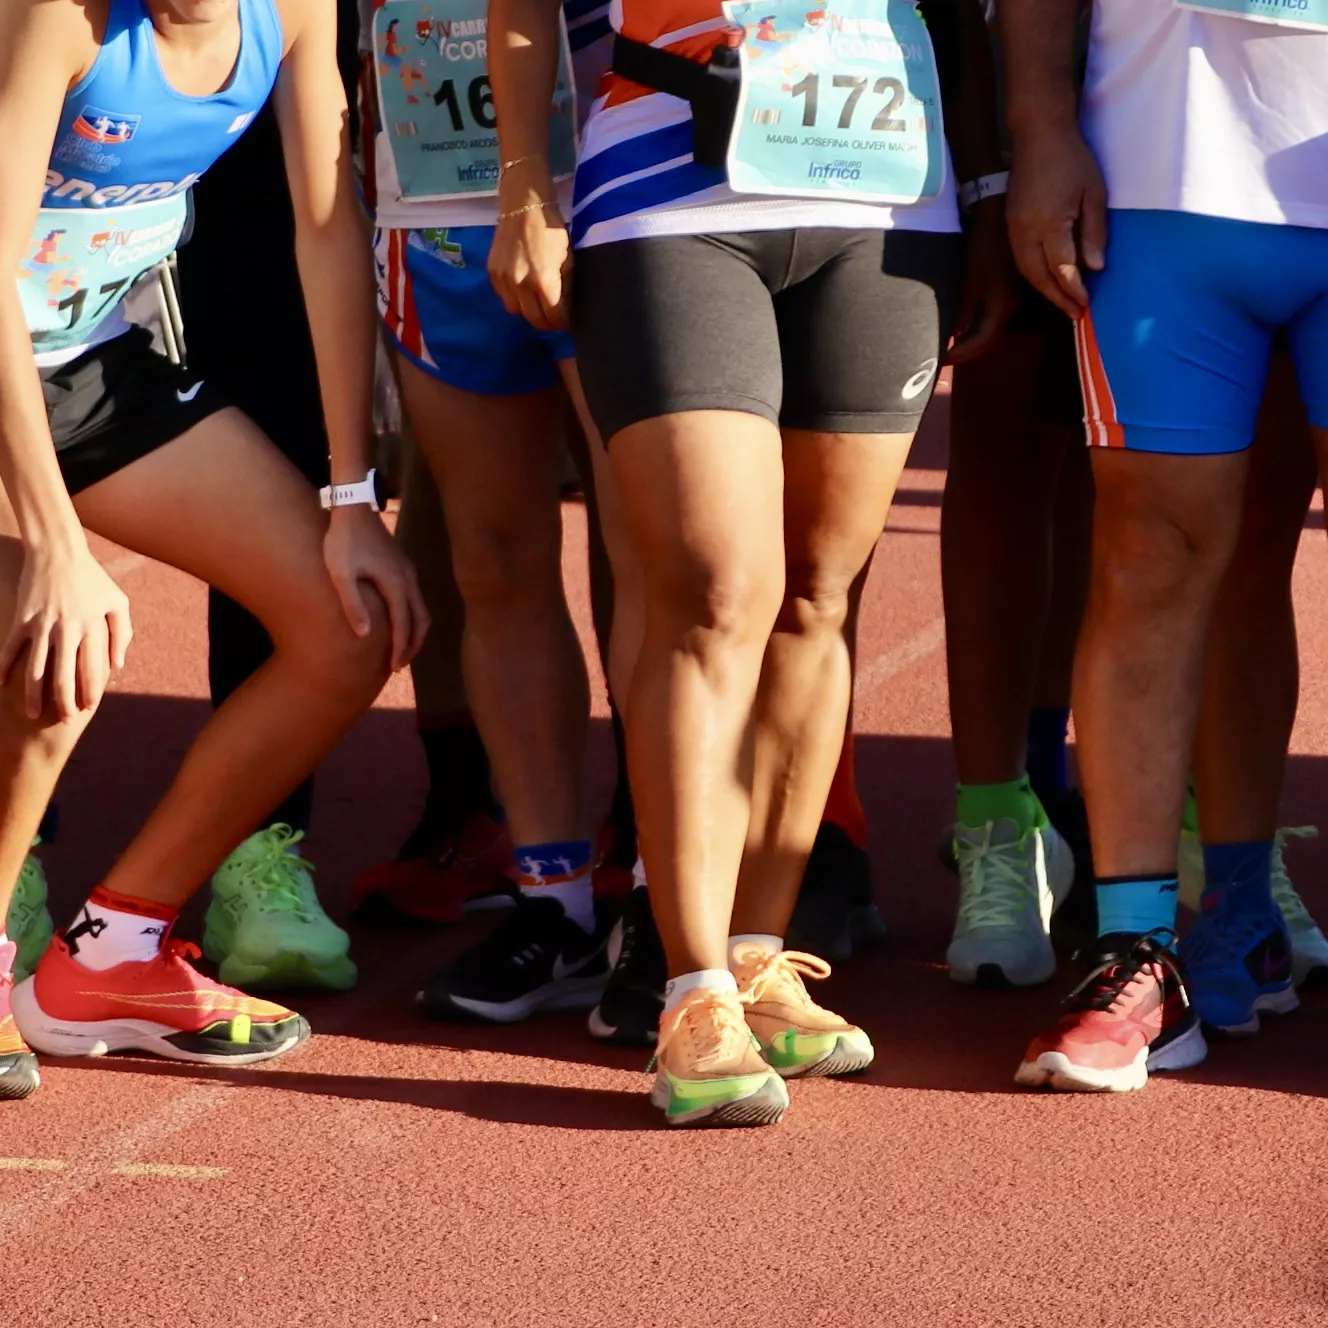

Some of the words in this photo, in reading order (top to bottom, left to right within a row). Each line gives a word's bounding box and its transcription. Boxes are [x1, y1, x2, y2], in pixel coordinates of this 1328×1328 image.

[792, 72, 906, 132] 172
[421, 141, 468, 153] FRANCISCO
[766, 134, 798, 145] MARIA
[801, 135, 849, 149] JOSEFINA
[852, 139, 886, 151] OLIVER
[807, 162, 861, 180] Infrico
[833, 159, 862, 169] GRUPO
